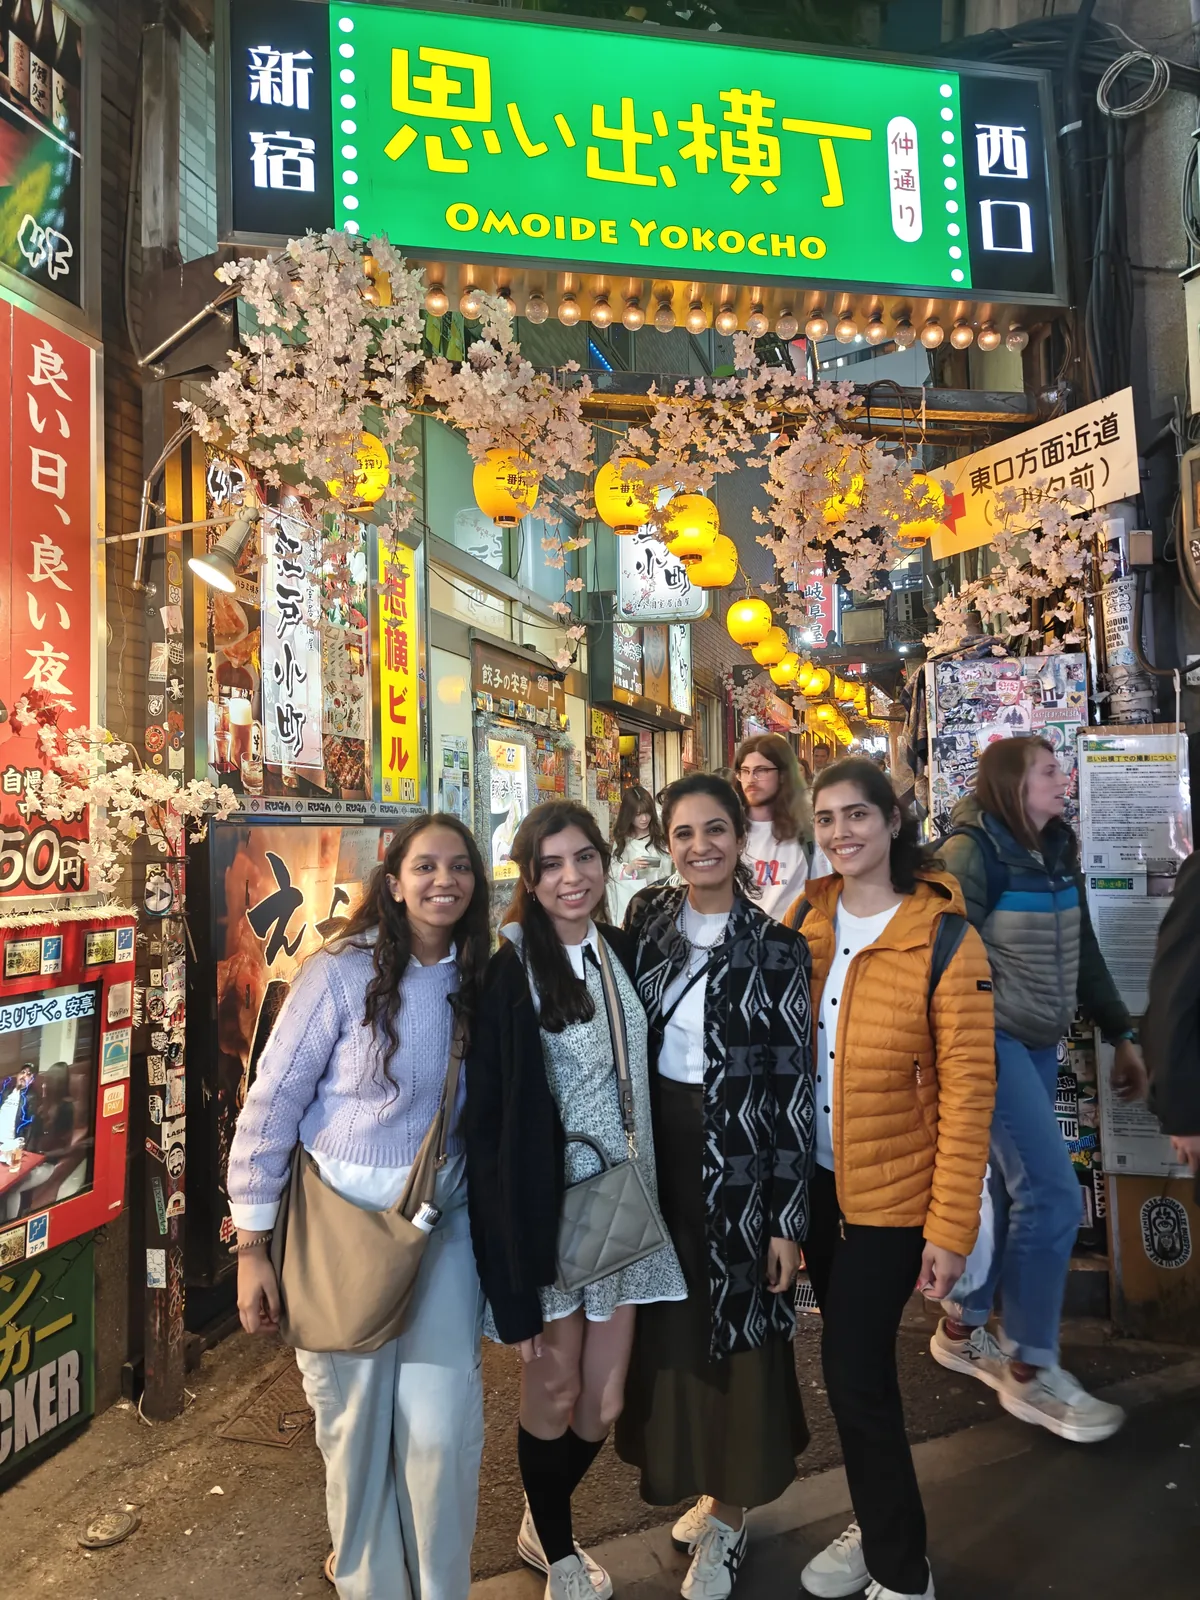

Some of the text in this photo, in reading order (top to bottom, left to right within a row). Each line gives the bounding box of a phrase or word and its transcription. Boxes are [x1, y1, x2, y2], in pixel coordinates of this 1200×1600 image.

[248, 45, 316, 193] 新宿
[383, 46, 872, 208] 思い出横丁
[891, 131, 917, 229] 仲通り
[975, 123, 1034, 254] 西口
[445, 202, 828, 261] OMOIDE YOKOCHO
[969, 411, 1121, 498] 東口方面近道
[804, 581, 827, 644] 岐阜屋
[481, 663, 528, 696] 餃子の安亭
[264, 802, 291, 813] RUGA
[307, 803, 331, 813] RUGA
[345, 804, 367, 813] RUGA
[756, 859, 780, 886] 22
[109, 1007, 130, 1019] PayPay
[107, 1101, 120, 1112] PAY
